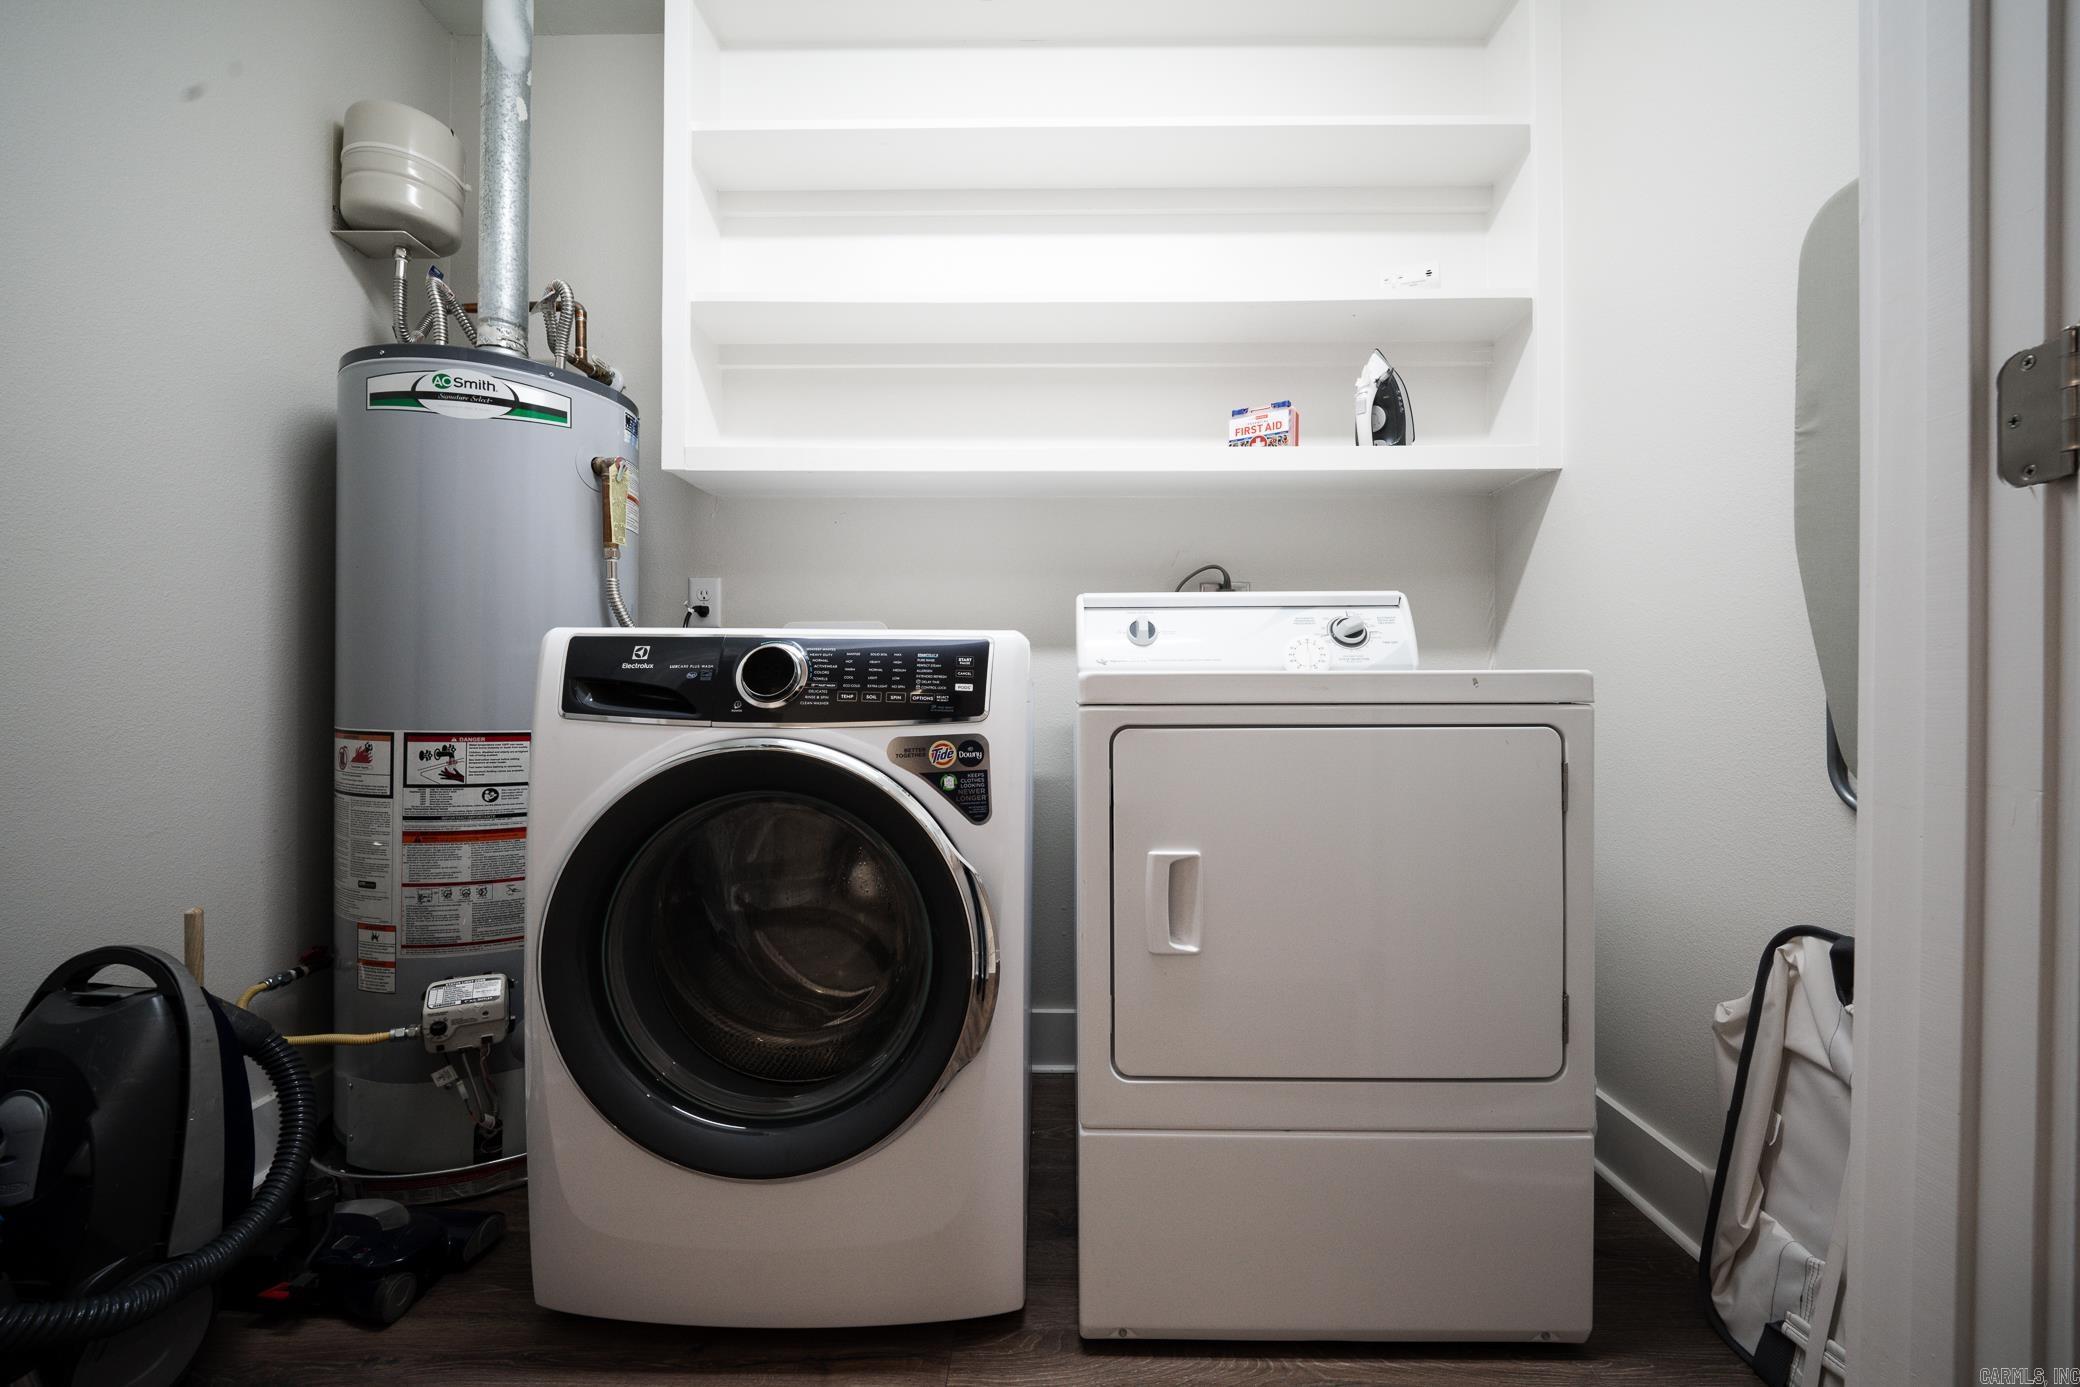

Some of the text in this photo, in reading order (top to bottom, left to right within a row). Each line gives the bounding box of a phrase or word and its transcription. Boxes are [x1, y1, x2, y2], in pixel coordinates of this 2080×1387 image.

[1235, 420, 1282, 437] FIRST AID
[932, 747, 954, 764] Tide
[958, 750, 982, 760] Downy
